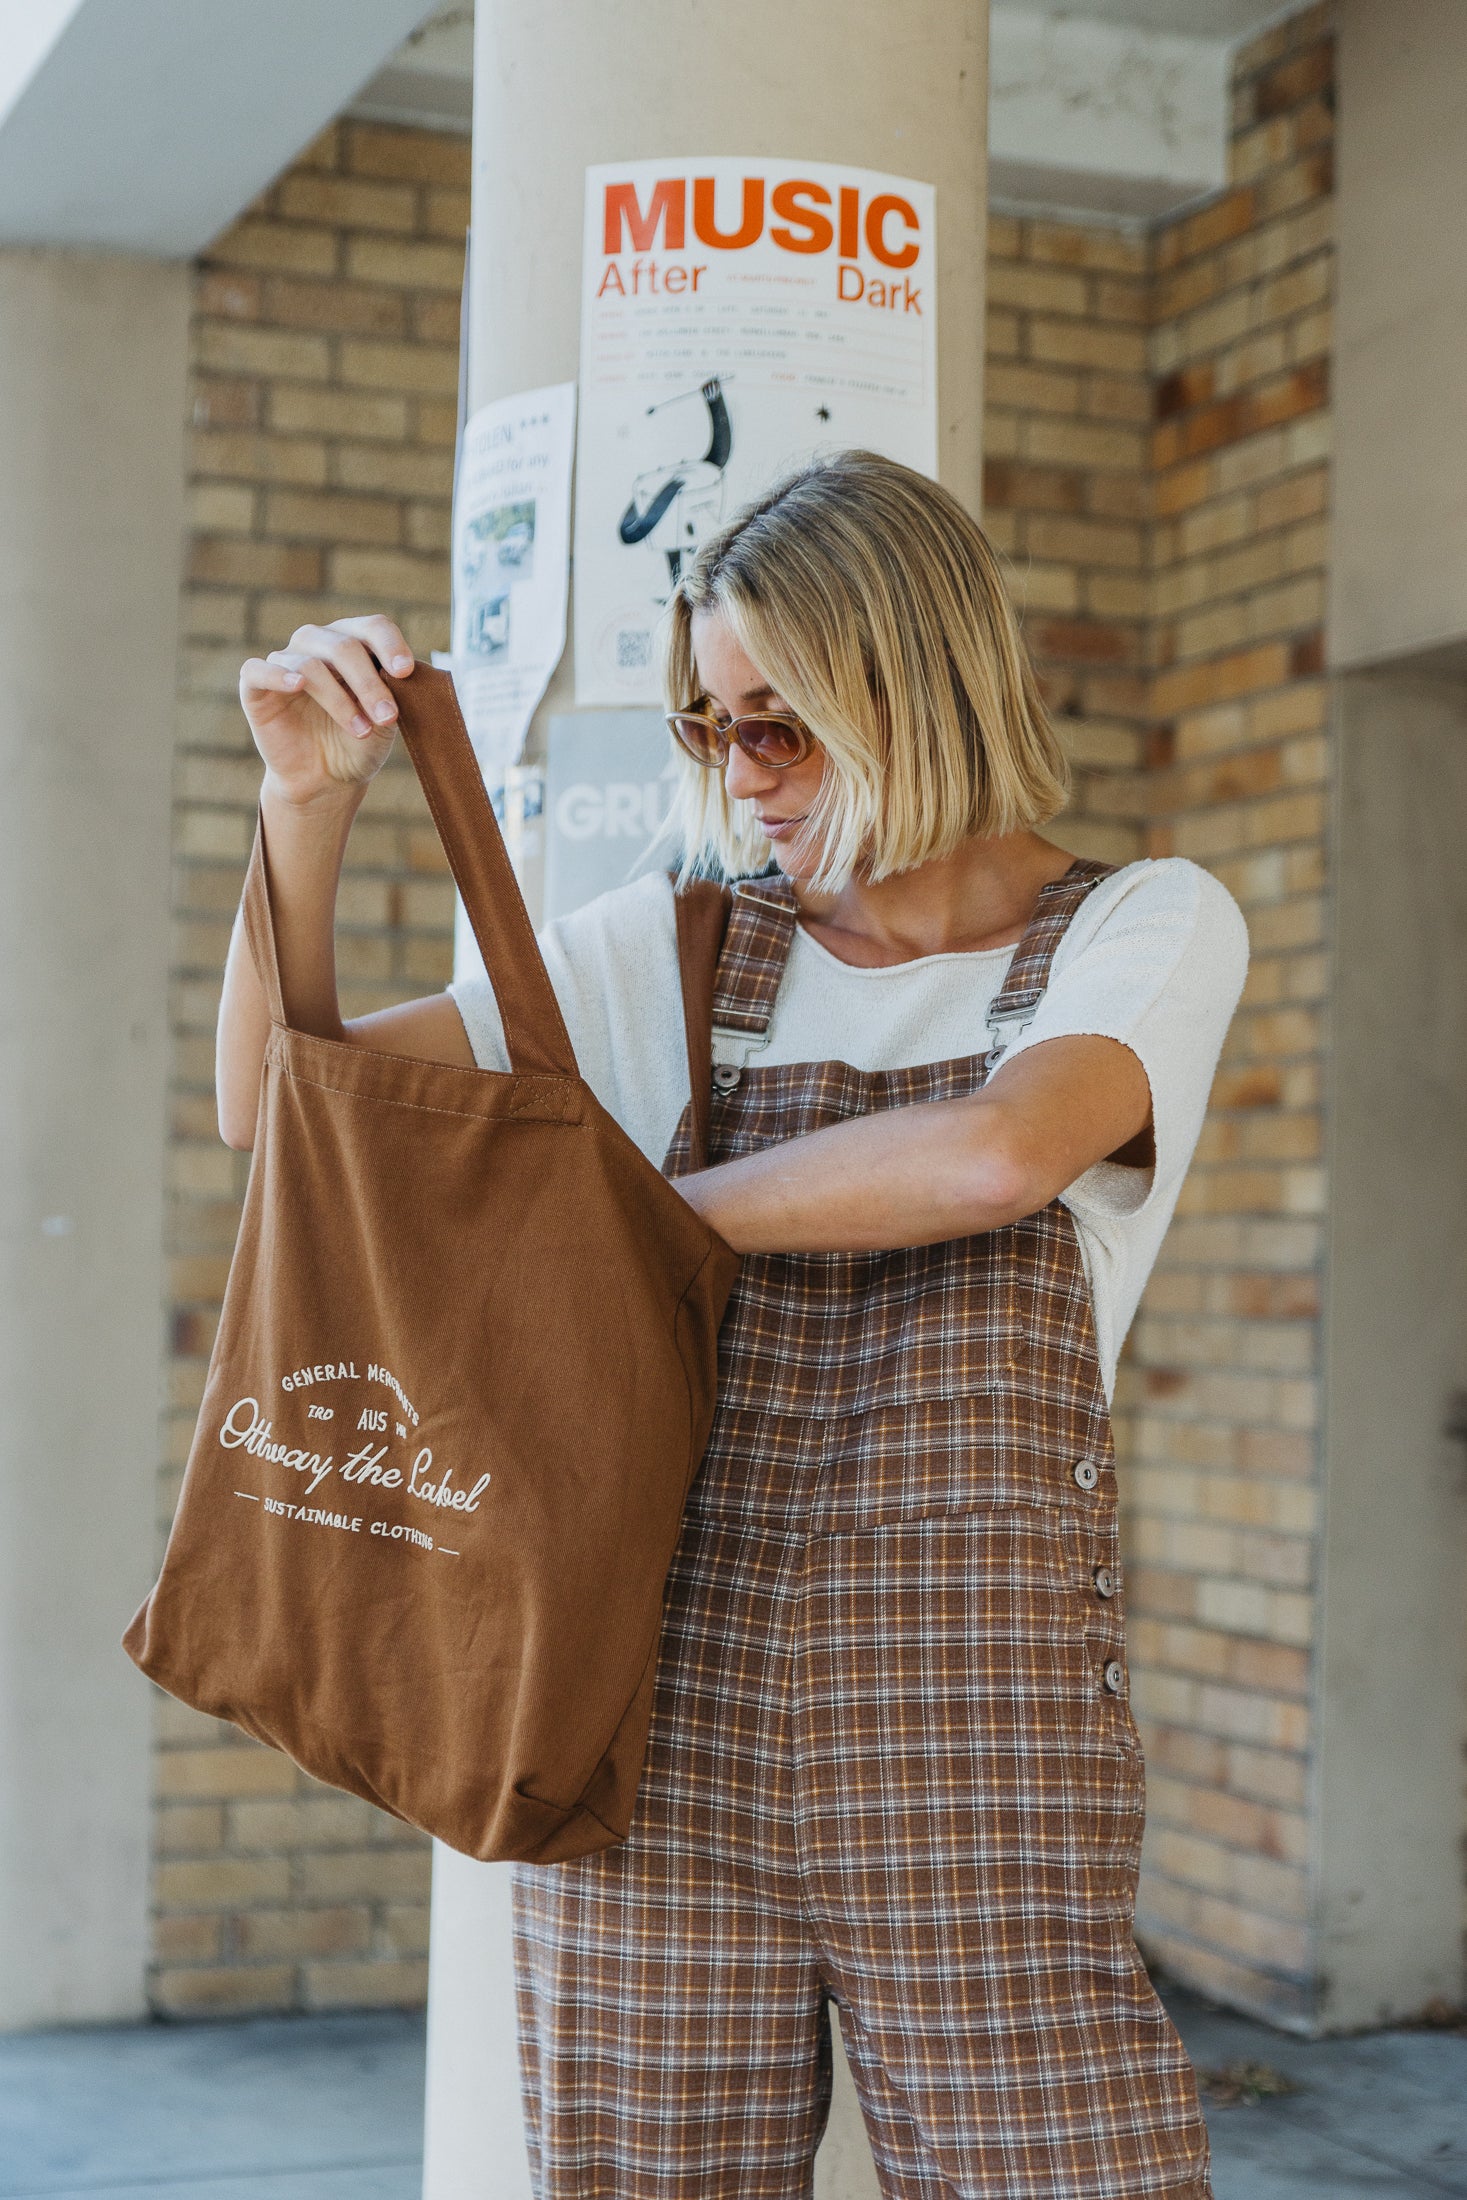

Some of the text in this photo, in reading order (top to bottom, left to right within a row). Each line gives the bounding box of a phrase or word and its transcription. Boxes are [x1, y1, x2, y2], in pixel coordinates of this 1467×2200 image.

[603, 177, 920, 269] MUSIC
[597, 259, 707, 298] After
[836, 264, 923, 316] Dark
[281, 1361, 420, 1427] GENERAL MERCHANTS
[356, 1407, 389, 1433] AUS
[338, 1442, 404, 1489] the
[407, 1447, 491, 1513] Label
[263, 1497, 434, 1551] SUSTAINABLE CLOTHING
